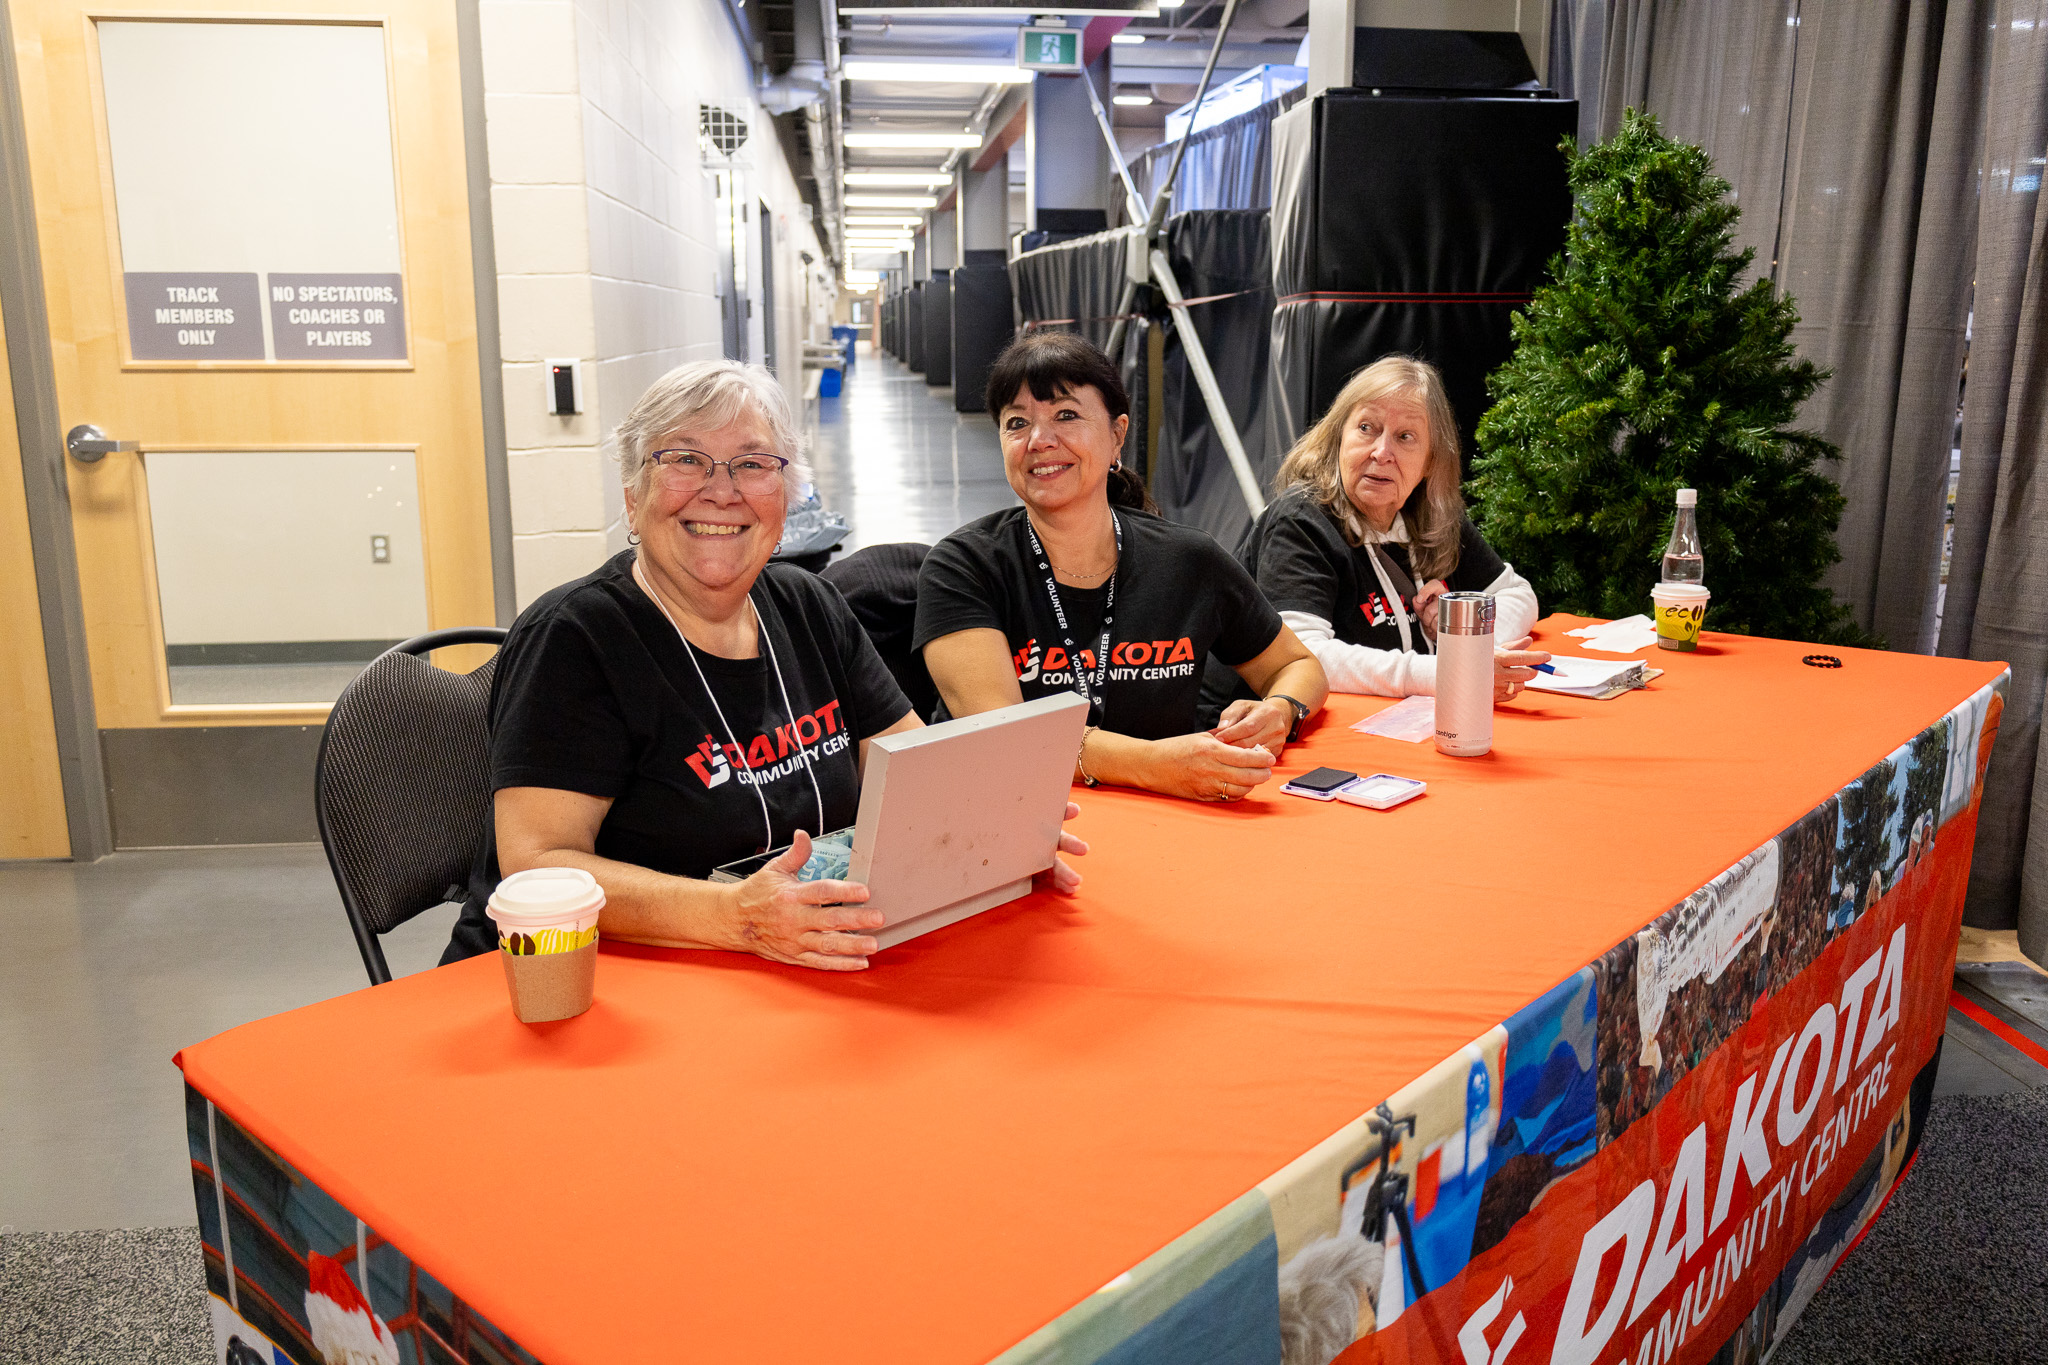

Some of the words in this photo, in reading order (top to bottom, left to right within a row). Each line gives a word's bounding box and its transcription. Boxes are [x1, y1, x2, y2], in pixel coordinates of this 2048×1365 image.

[166, 286, 219, 303] TRACK
[272, 286, 295, 302] NO
[298, 286, 399, 304] SPECTATORS,
[155, 308, 235, 325] MEMBERS
[288, 308, 360, 325] COACHES
[363, 308, 386, 325] OR
[177, 329, 217, 346] ONLY
[306, 330, 373, 347] PLAYERS
[1045, 577, 1068, 630] VOLUNTEER
[1095, 633, 1110, 687] VOLUNTEER
[1071, 654, 1089, 699] VOLUNTE
[721, 698, 845, 769] DAKOT
[1799, 1042, 1897, 1198] CENTRE
[1550, 922, 1907, 1365] DAKOTA
